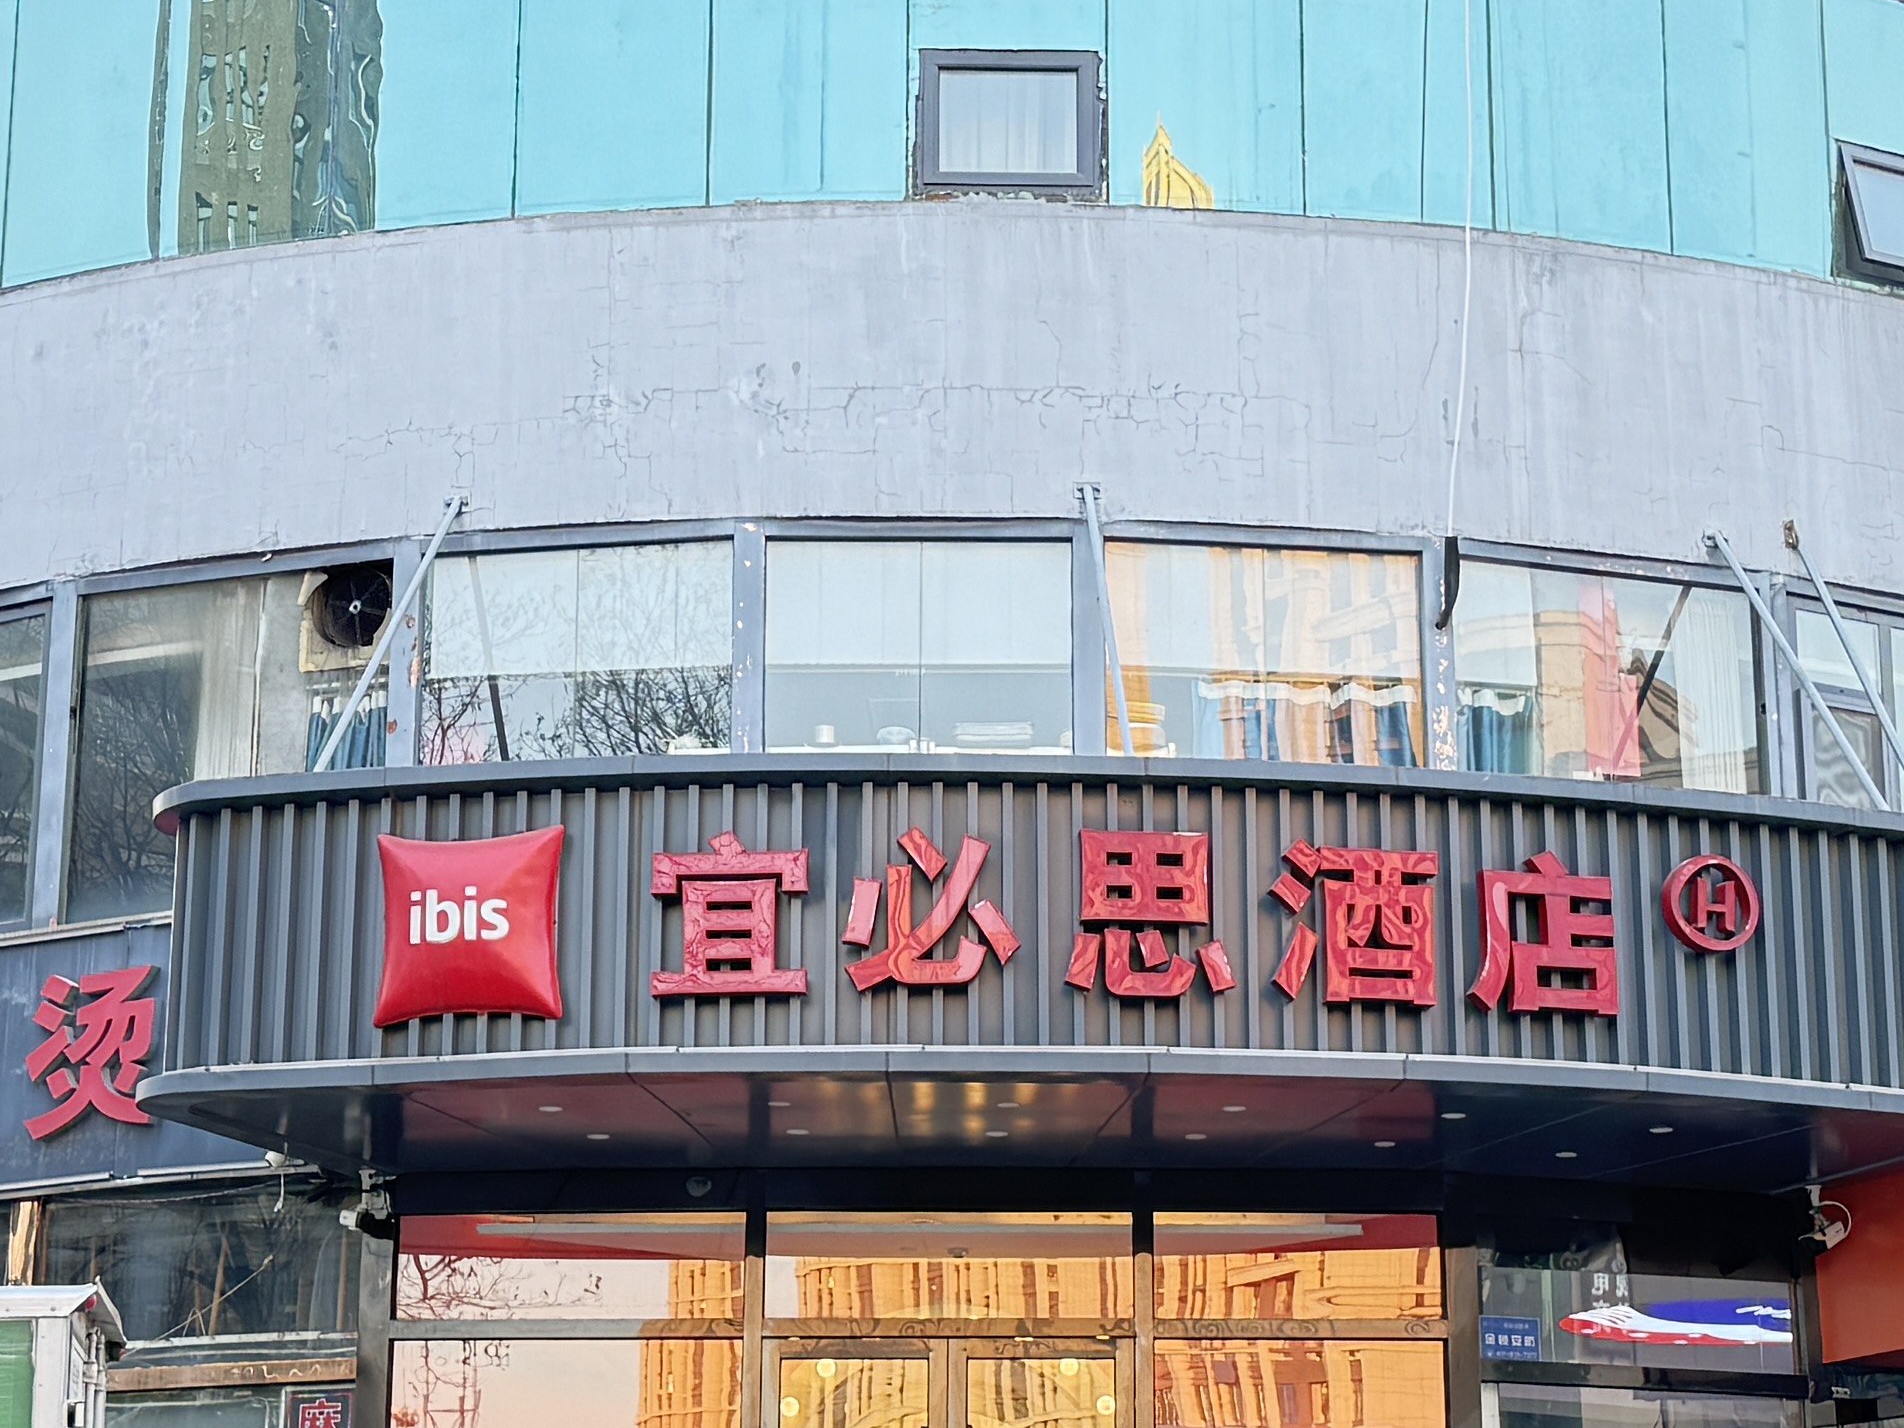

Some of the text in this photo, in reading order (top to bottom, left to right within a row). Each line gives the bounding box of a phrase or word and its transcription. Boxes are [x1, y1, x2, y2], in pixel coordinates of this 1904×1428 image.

[408, 884, 509, 947] ibis
[650, 825, 1620, 1018] 宜必思酒店
